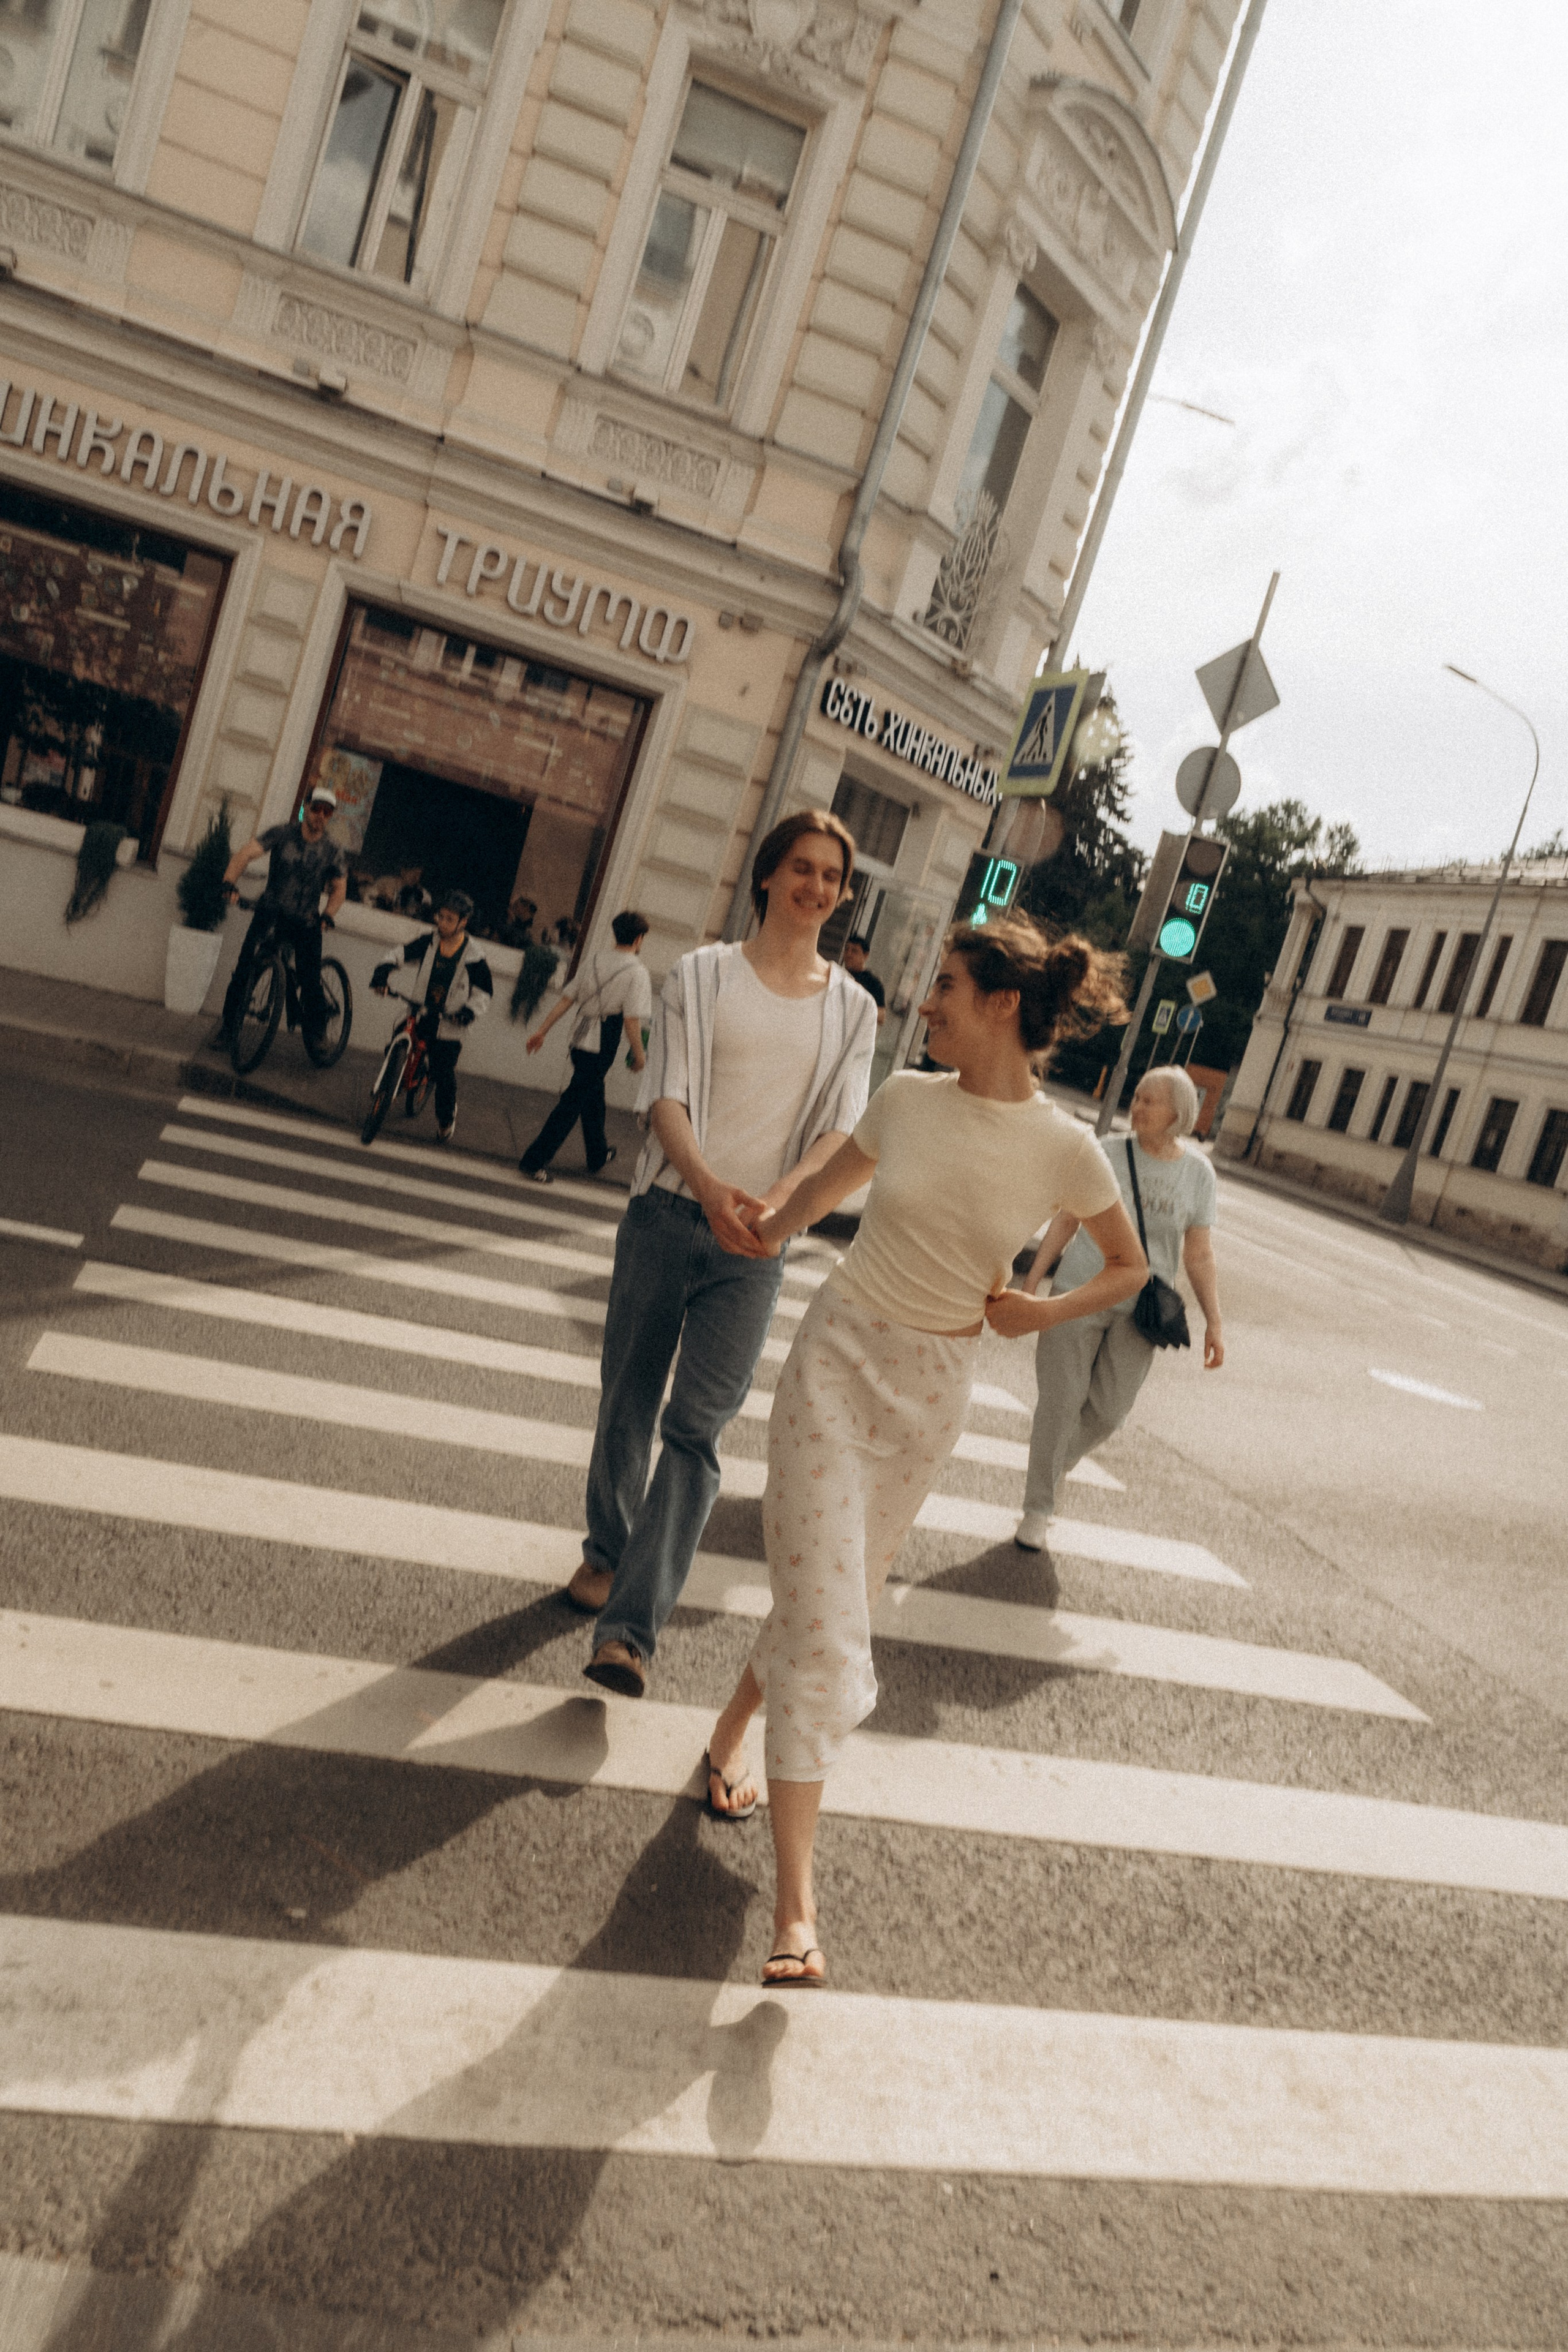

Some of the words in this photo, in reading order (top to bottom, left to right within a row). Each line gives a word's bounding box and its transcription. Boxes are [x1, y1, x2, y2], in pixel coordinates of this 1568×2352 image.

[436, 524, 696, 665] ТРИУМФ
[826, 676, 878, 740] СЕТЬ
[981, 858, 1017, 906] 10
